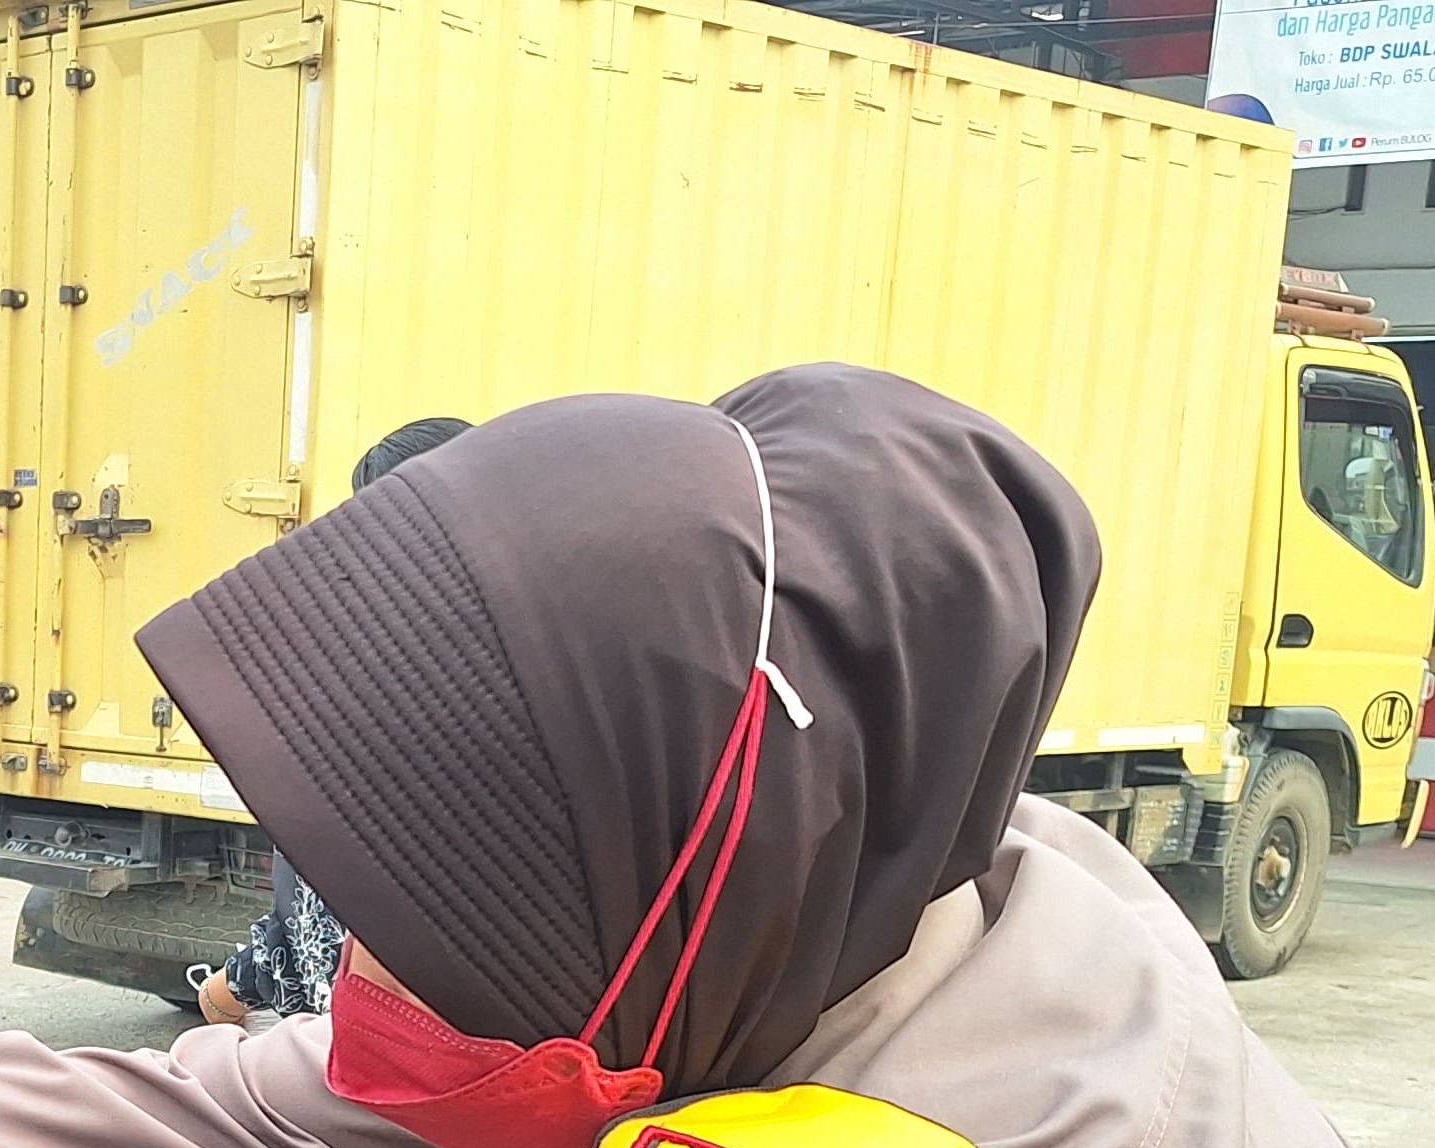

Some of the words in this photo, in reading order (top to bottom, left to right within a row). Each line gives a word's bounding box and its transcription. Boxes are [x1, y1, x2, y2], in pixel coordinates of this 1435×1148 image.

[1277, 12, 1309, 37] dan
[1316, 9, 1371, 36] Harga
[1299, 50, 1326, 66] Toko
[1340, 46, 1375, 63] BDP
[1380, 40, 1435, 60] SWAL
[1294, 77, 1330, 95] Harga
[1334, 75, 1360, 90] Jual
